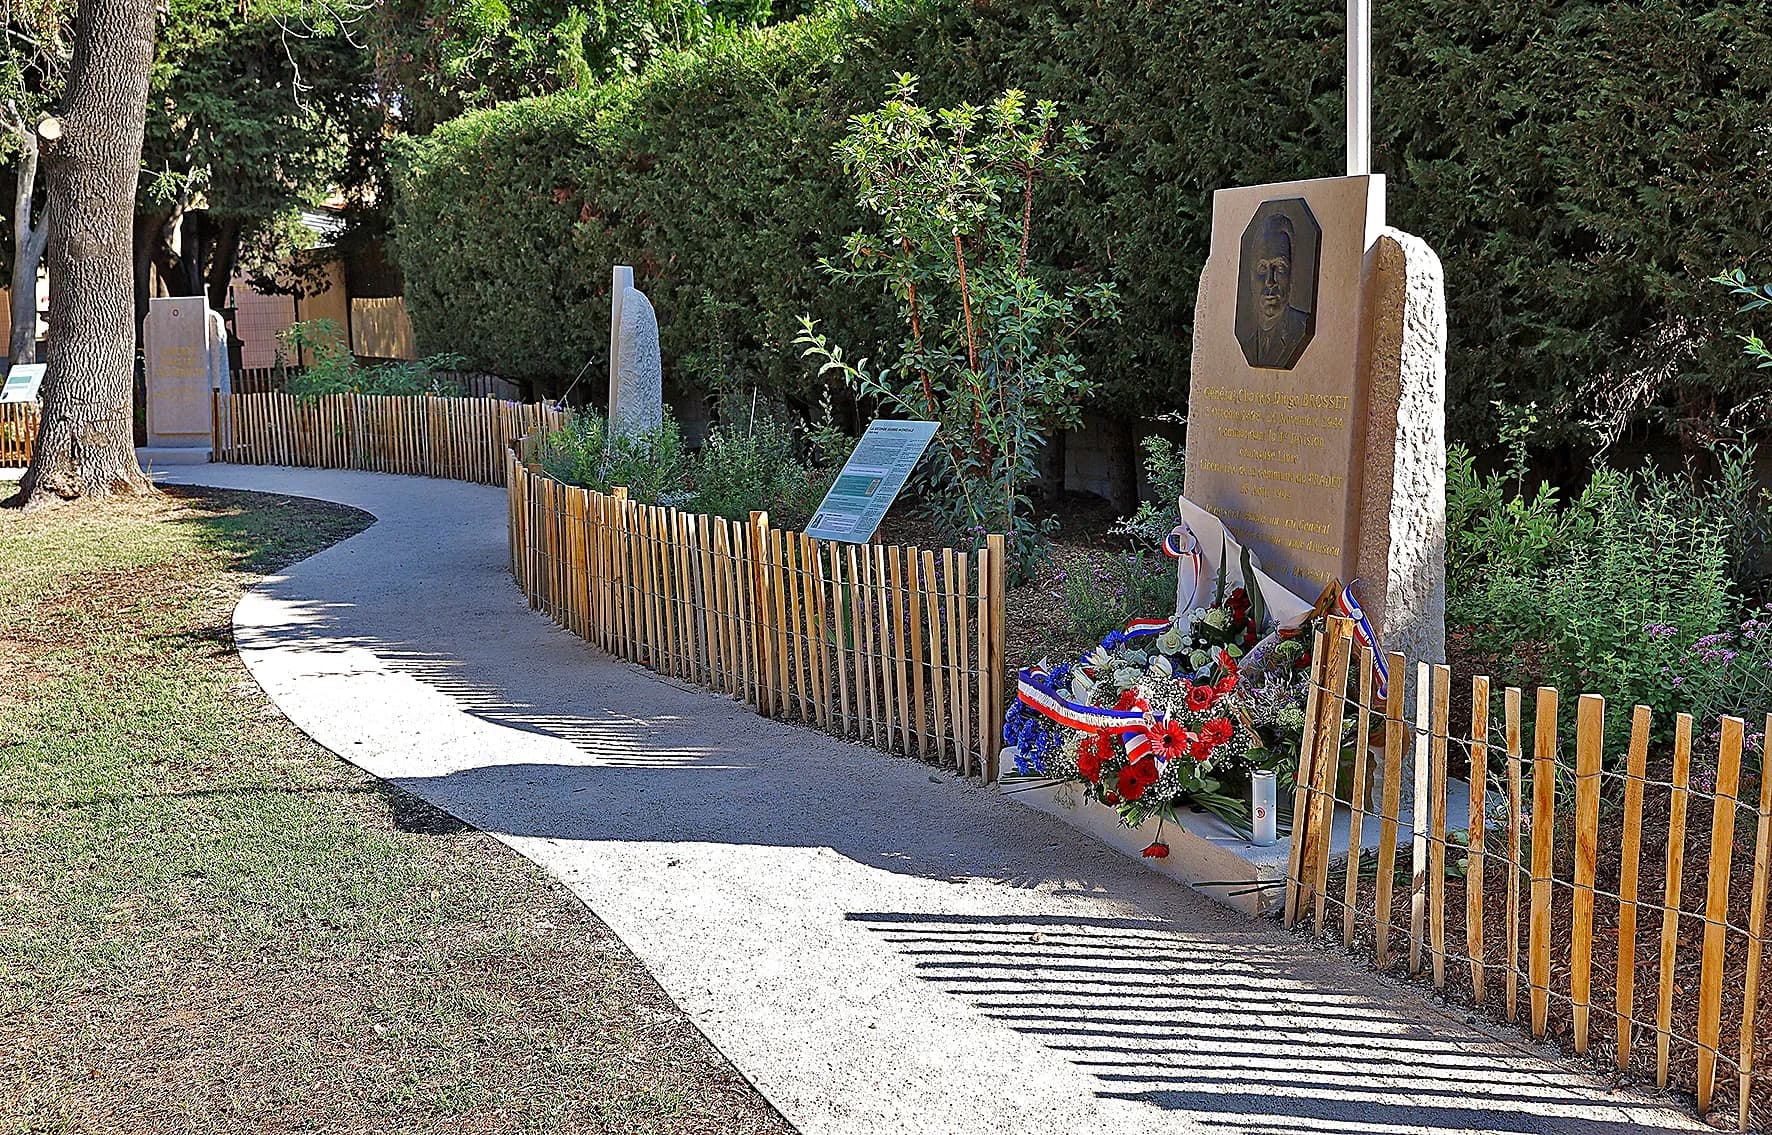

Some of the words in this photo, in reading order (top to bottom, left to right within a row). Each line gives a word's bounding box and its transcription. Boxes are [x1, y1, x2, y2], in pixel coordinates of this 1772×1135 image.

[1203, 386, 1235, 402] Général
[1237, 387, 1270, 404] Charles
[1273, 391, 1299, 410] Diego
[1301, 393, 1349, 411] BROSSET
[1308, 472, 1343, 490] PRADET
[1306, 538, 1341, 557] division
